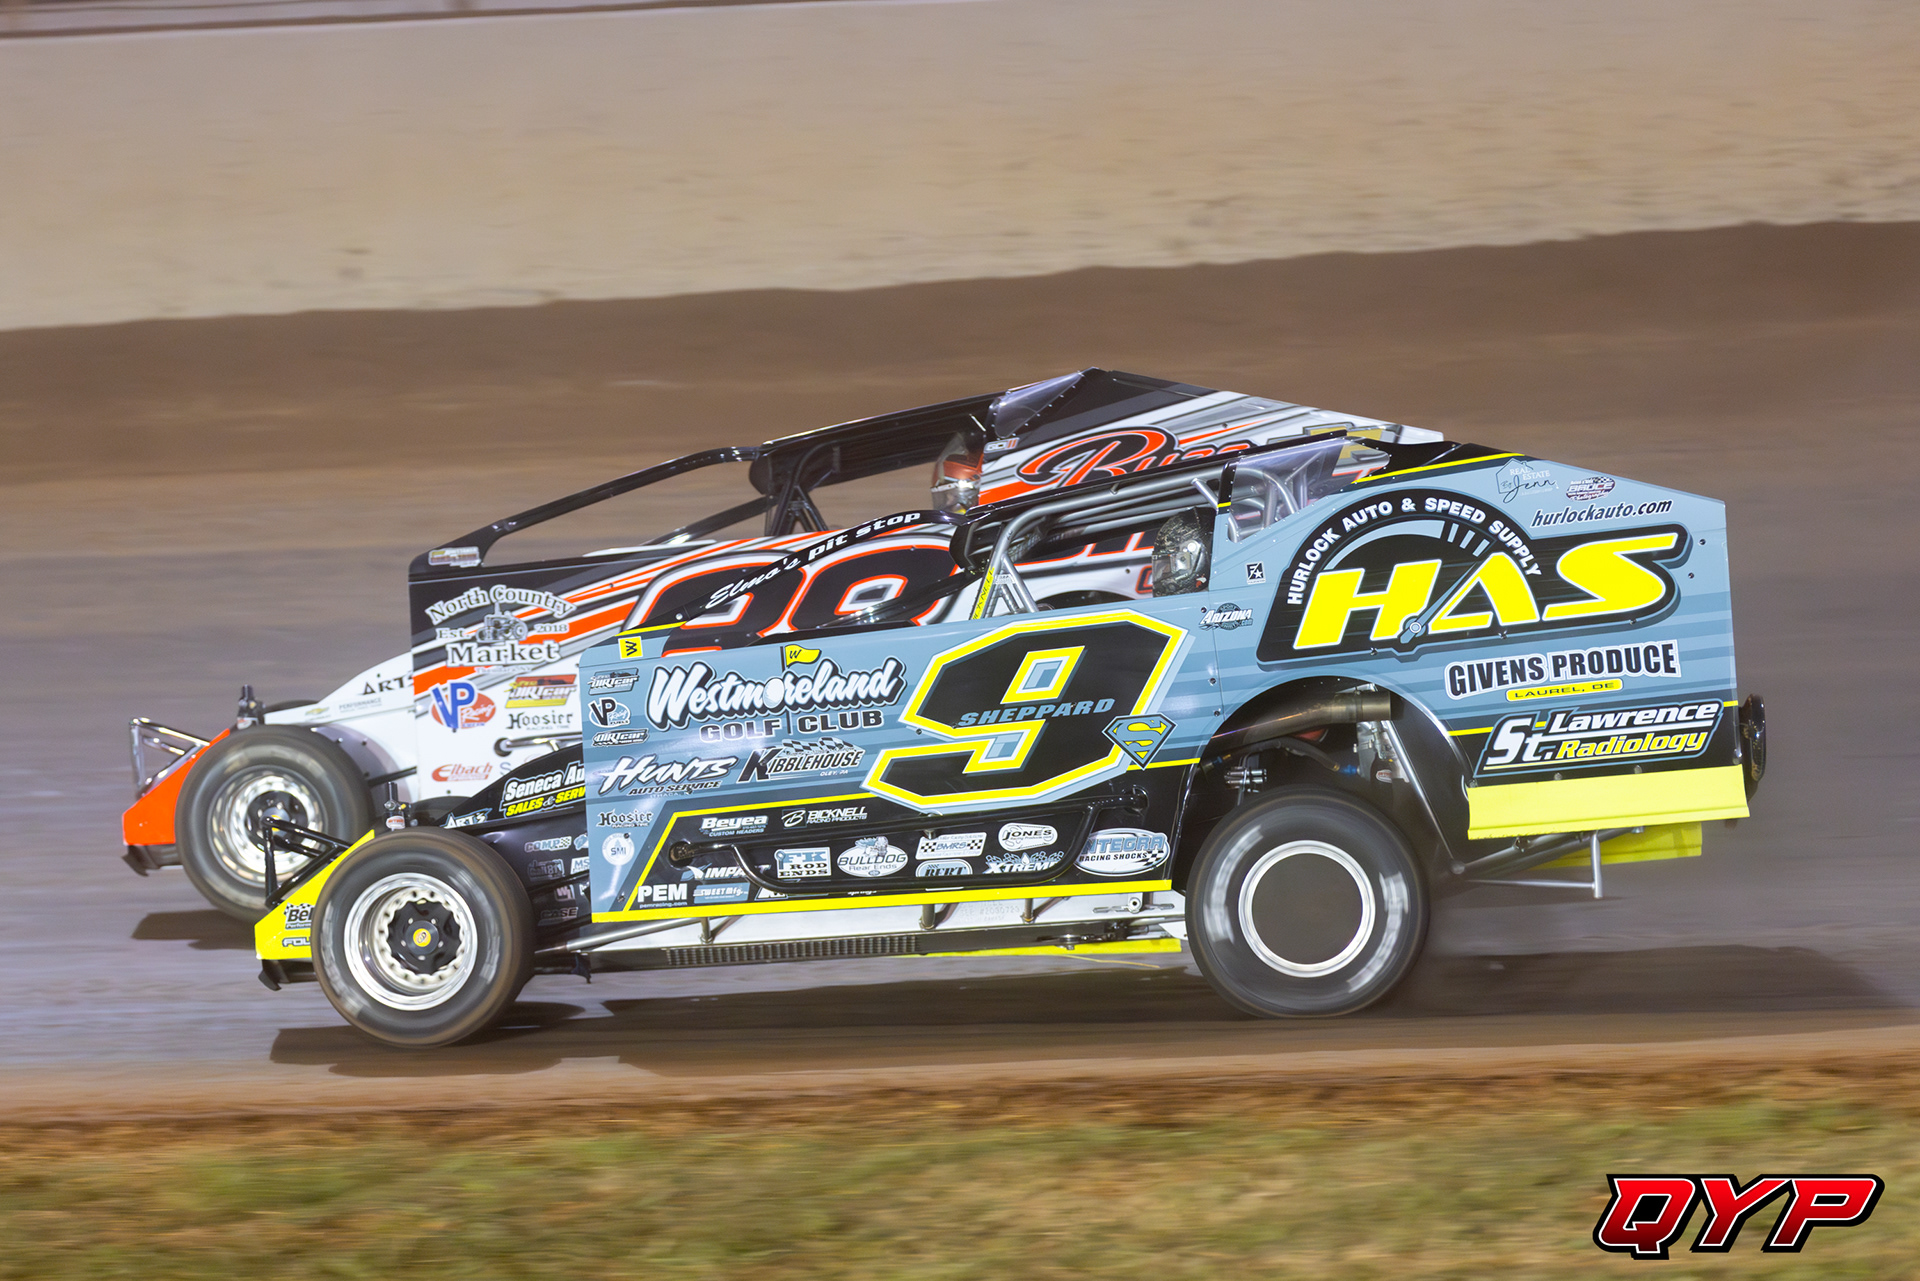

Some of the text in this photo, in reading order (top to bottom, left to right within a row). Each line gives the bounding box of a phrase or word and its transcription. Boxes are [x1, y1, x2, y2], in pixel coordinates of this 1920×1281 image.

[1510, 466, 1530, 475] REAL
[1522, 469, 1550, 480] ESTATE
[1503, 475, 1557, 504] Jenn
[1531, 499, 1673, 527] hurlockauto.com
[808, 534, 848, 560] pit
[855, 512, 920, 538] stop
[1287, 497, 1543, 605] HURLOCK AUTO & SPEED SUPPLY
[1293, 531, 1681, 651] HAS
[427, 586, 576, 623] North Country
[1200, 609, 1252, 625] ARIZONA
[438, 624, 568, 639] Est. 2018
[449, 641, 559, 664] Market
[789, 649, 801, 660] W
[1449, 643, 1678, 697] GIVENS PRODUCE
[647, 658, 904, 729] Westmoreland
[1515, 682, 1615, 698] LAUREL, DE
[432, 682, 475, 728] VP
[590, 698, 616, 726] VP
[861, 609, 1188, 808] 9
[957, 698, 1116, 727] SHEPPARD
[506, 710, 573, 729] Hoosier
[700, 710, 883, 742] GOLF CLUB
[1549, 702, 1720, 733] Lawrence
[593, 732, 645, 744] DIRTcar
[1487, 717, 1553, 766] St.
[1556, 731, 1707, 760] Radiology
[432, 763, 492, 782] Eibach
[737, 746, 865, 783] KIBBLEHOUSE
[505, 773, 562, 800] Seneca
[628, 781, 722, 795] AUTO SERVICE
[506, 797, 544, 816] SALES
[543, 796, 555, 806] &
[808, 807, 867, 820] BICKNELL
[597, 809, 654, 827] Hoosier
[702, 815, 768, 831] Beyea
[831, 814, 867, 822] PRODUCTS
[736, 827, 765, 835] HEADERS
[1002, 829, 1052, 840] JONES
[1081, 835, 1165, 855] NTEGRA
[784, 851, 826, 864] FK
[790, 862, 827, 870] ROD
[838, 853, 907, 866] BULLDOG
[849, 862, 898, 871] Rear Ends
[1080, 852, 1148, 862] RACING SHOCKS
[779, 868, 828, 877] ENDS
[637, 883, 688, 902] PEM
